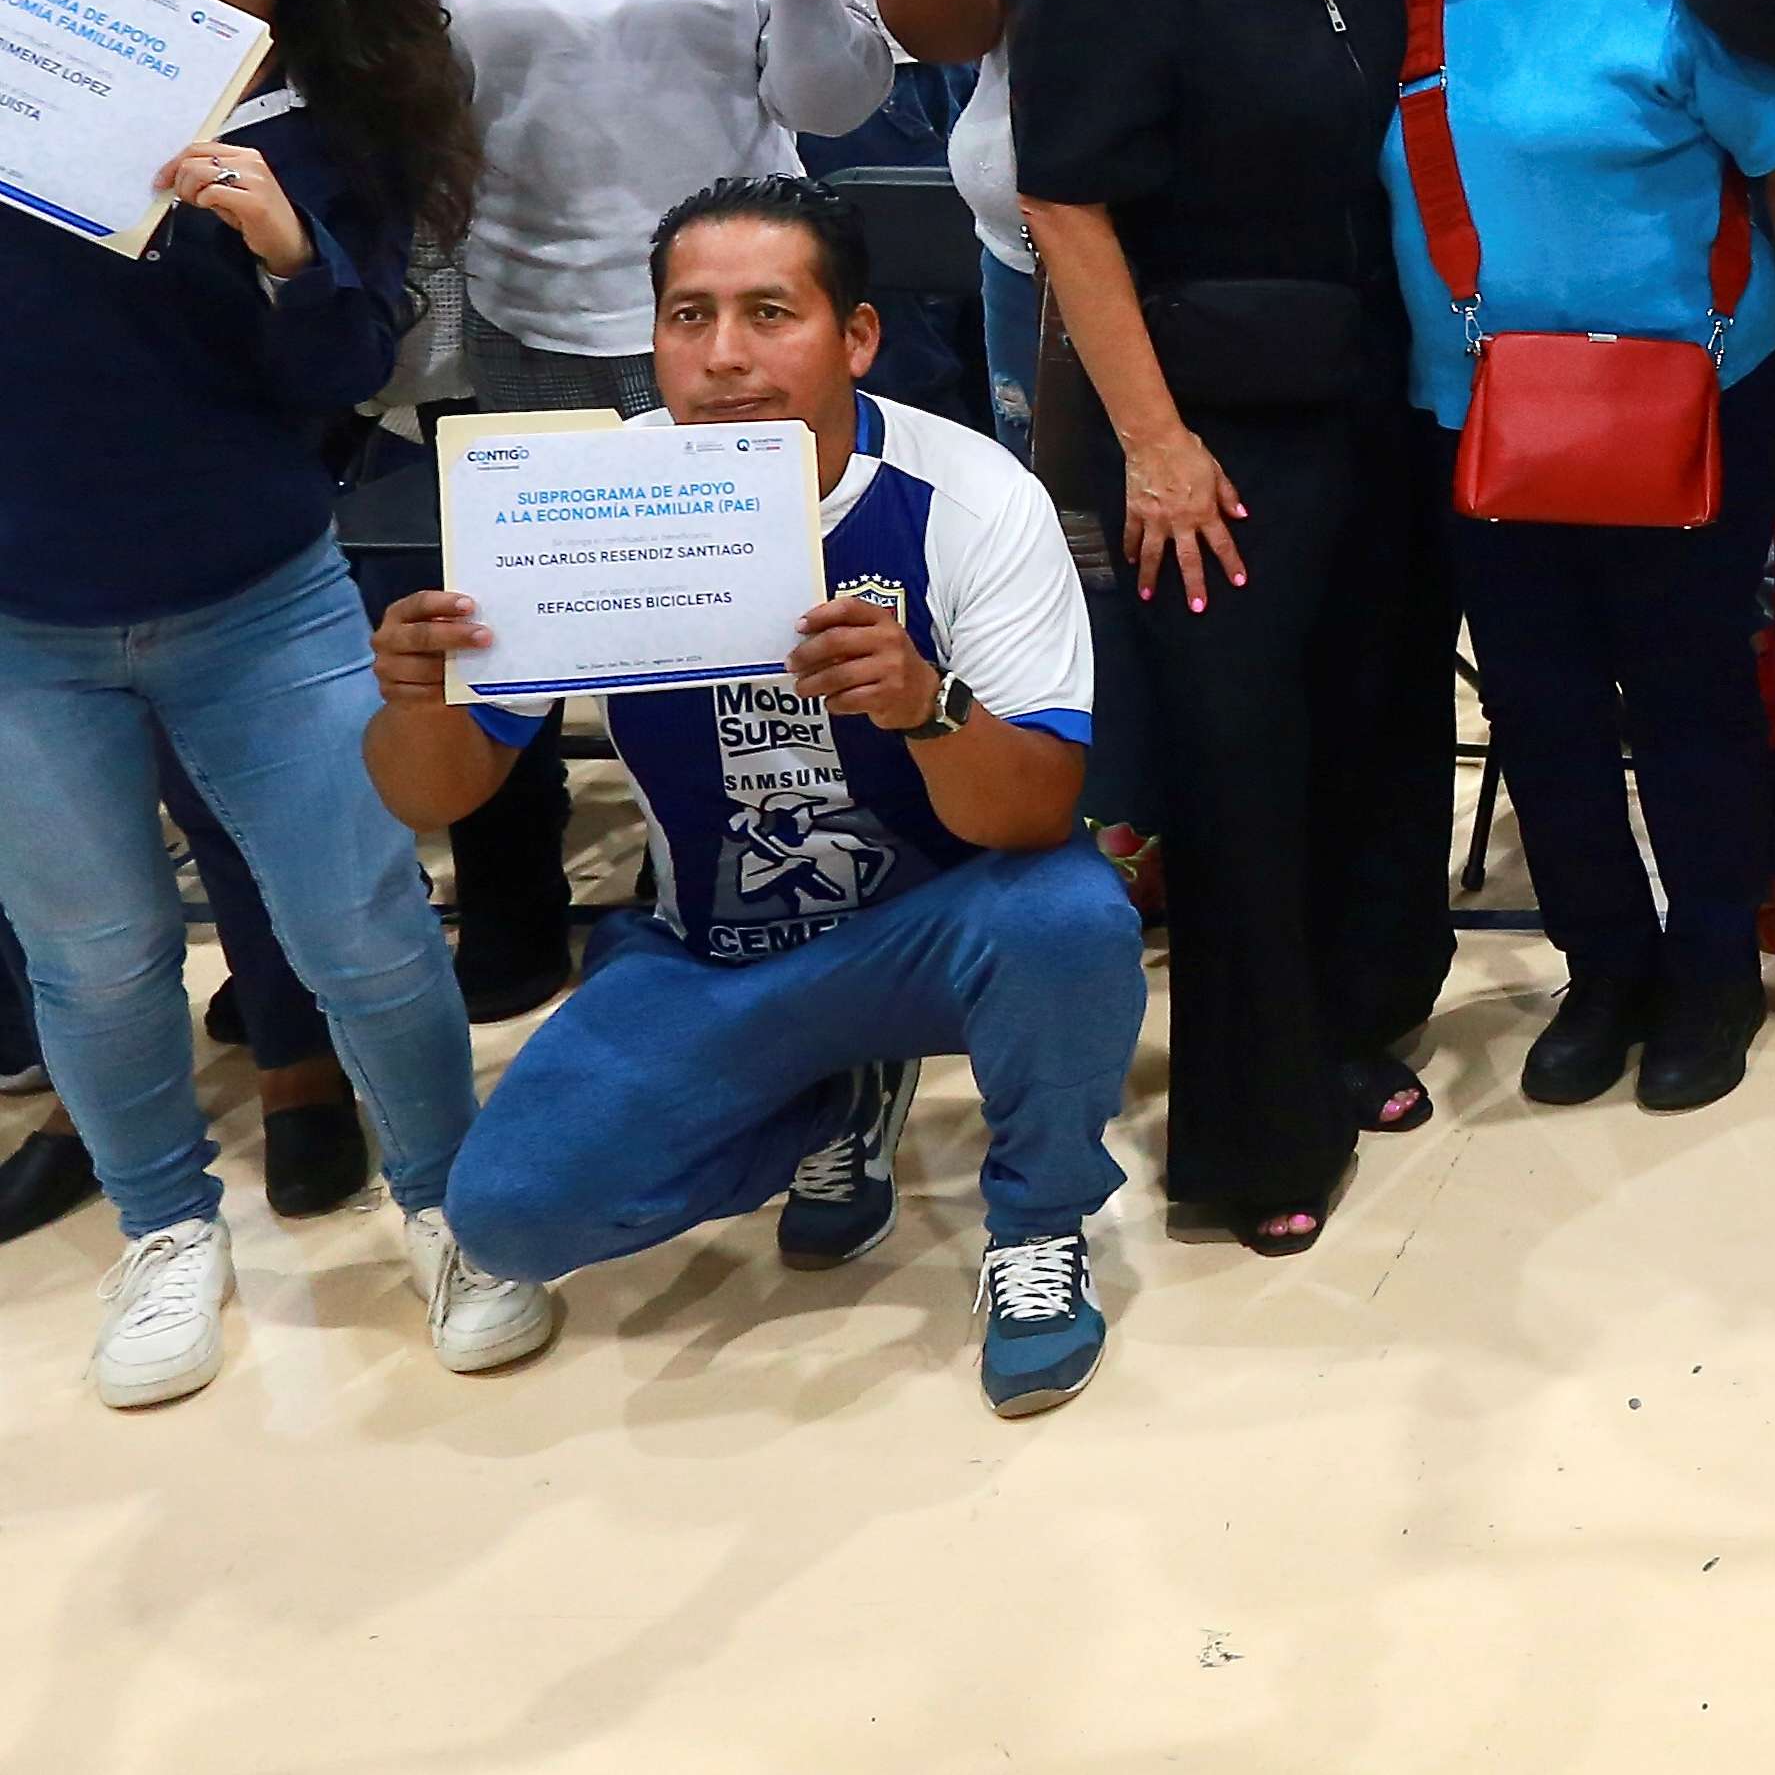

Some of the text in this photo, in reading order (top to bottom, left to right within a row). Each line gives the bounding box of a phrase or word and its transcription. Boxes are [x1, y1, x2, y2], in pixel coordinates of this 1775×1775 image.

[467, 445, 530, 464] CONTIGO
[517, 482, 736, 506] SUBPROGRAMA DE APOYO
[496, 498, 760, 525] A LA ECONOMÍA FAMILIAR (PAE)
[495, 543, 754, 568] JUAN CARLOS RESENDIZ SANTIAGO
[537, 592, 732, 615] REFACCIONES BICICLETAS
[720, 717, 824, 750] Super
[725, 768, 845, 791] SAMSUNG
